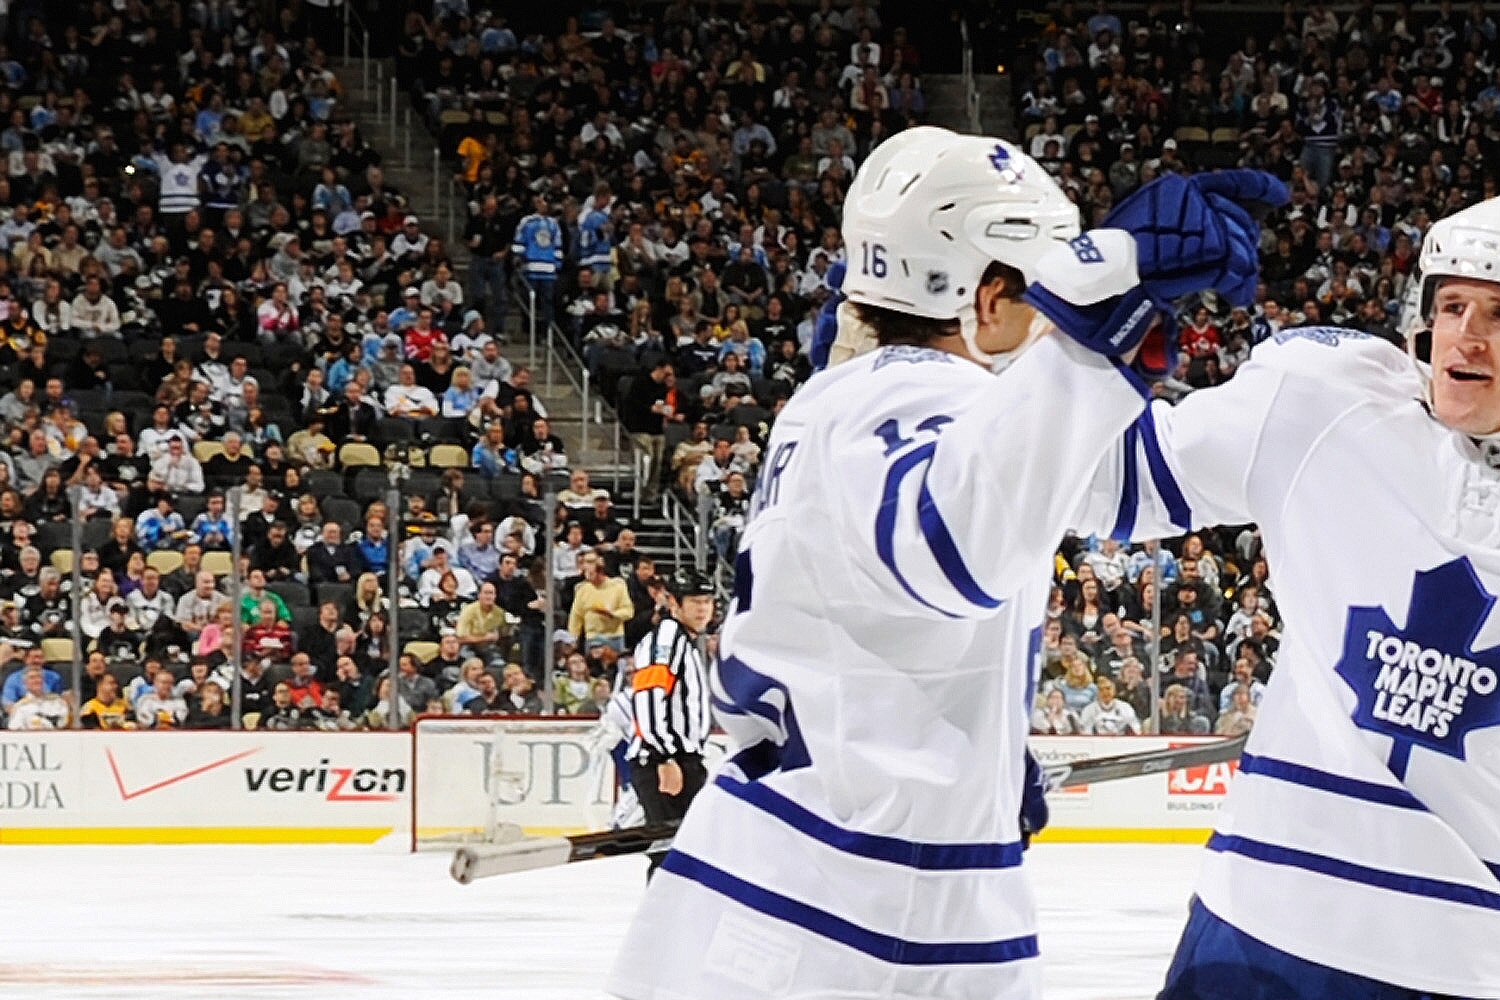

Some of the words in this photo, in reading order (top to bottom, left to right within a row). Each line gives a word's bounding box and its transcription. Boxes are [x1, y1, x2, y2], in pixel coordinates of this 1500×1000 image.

[861, 241, 888, 278] 16
[1366, 630, 1498, 694] TORONTO
[1372, 690, 1454, 738] LEAFS
[1375, 667, 1468, 716] MAPLE
[0, 781, 65, 810] DIA
[243, 757, 406, 802] verizon
